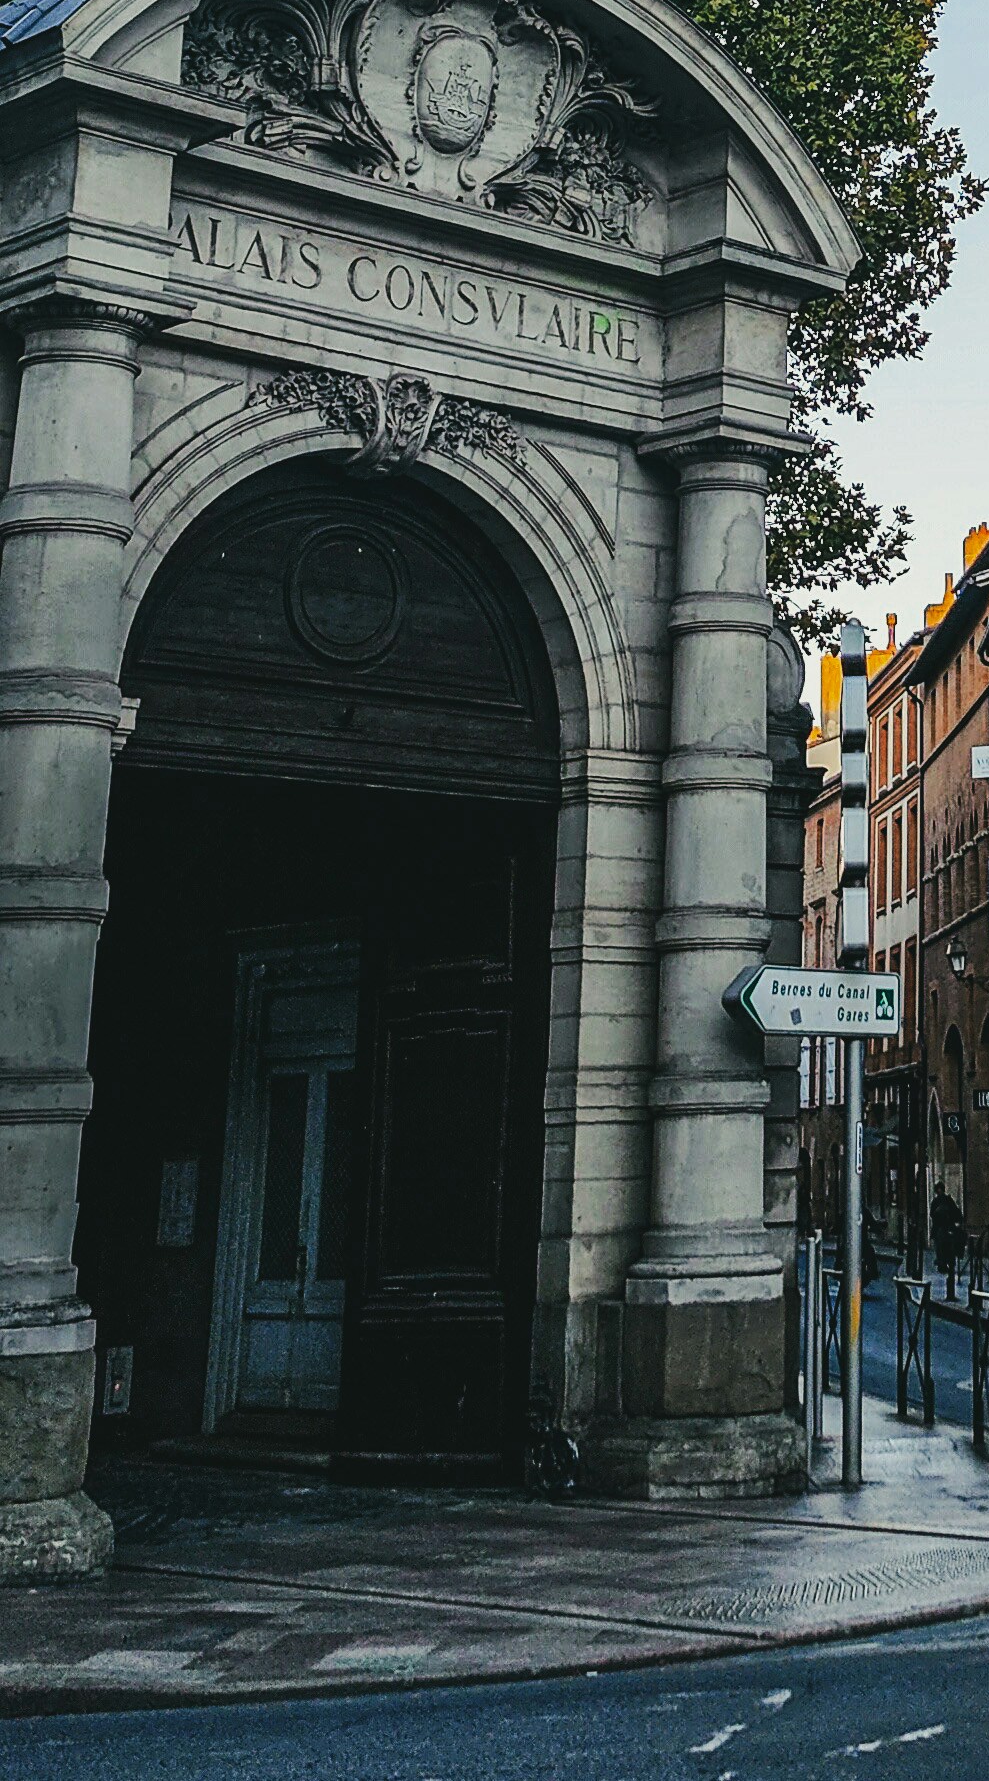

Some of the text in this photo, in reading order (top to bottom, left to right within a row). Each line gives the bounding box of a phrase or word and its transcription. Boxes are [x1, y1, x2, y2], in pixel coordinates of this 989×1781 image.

[168, 211, 642, 365] ALAIS CONSVLAIRE
[818, 982, 832, 998] du
[837, 983, 870, 1000] Canal
[837, 1006, 870, 1022] Gares
